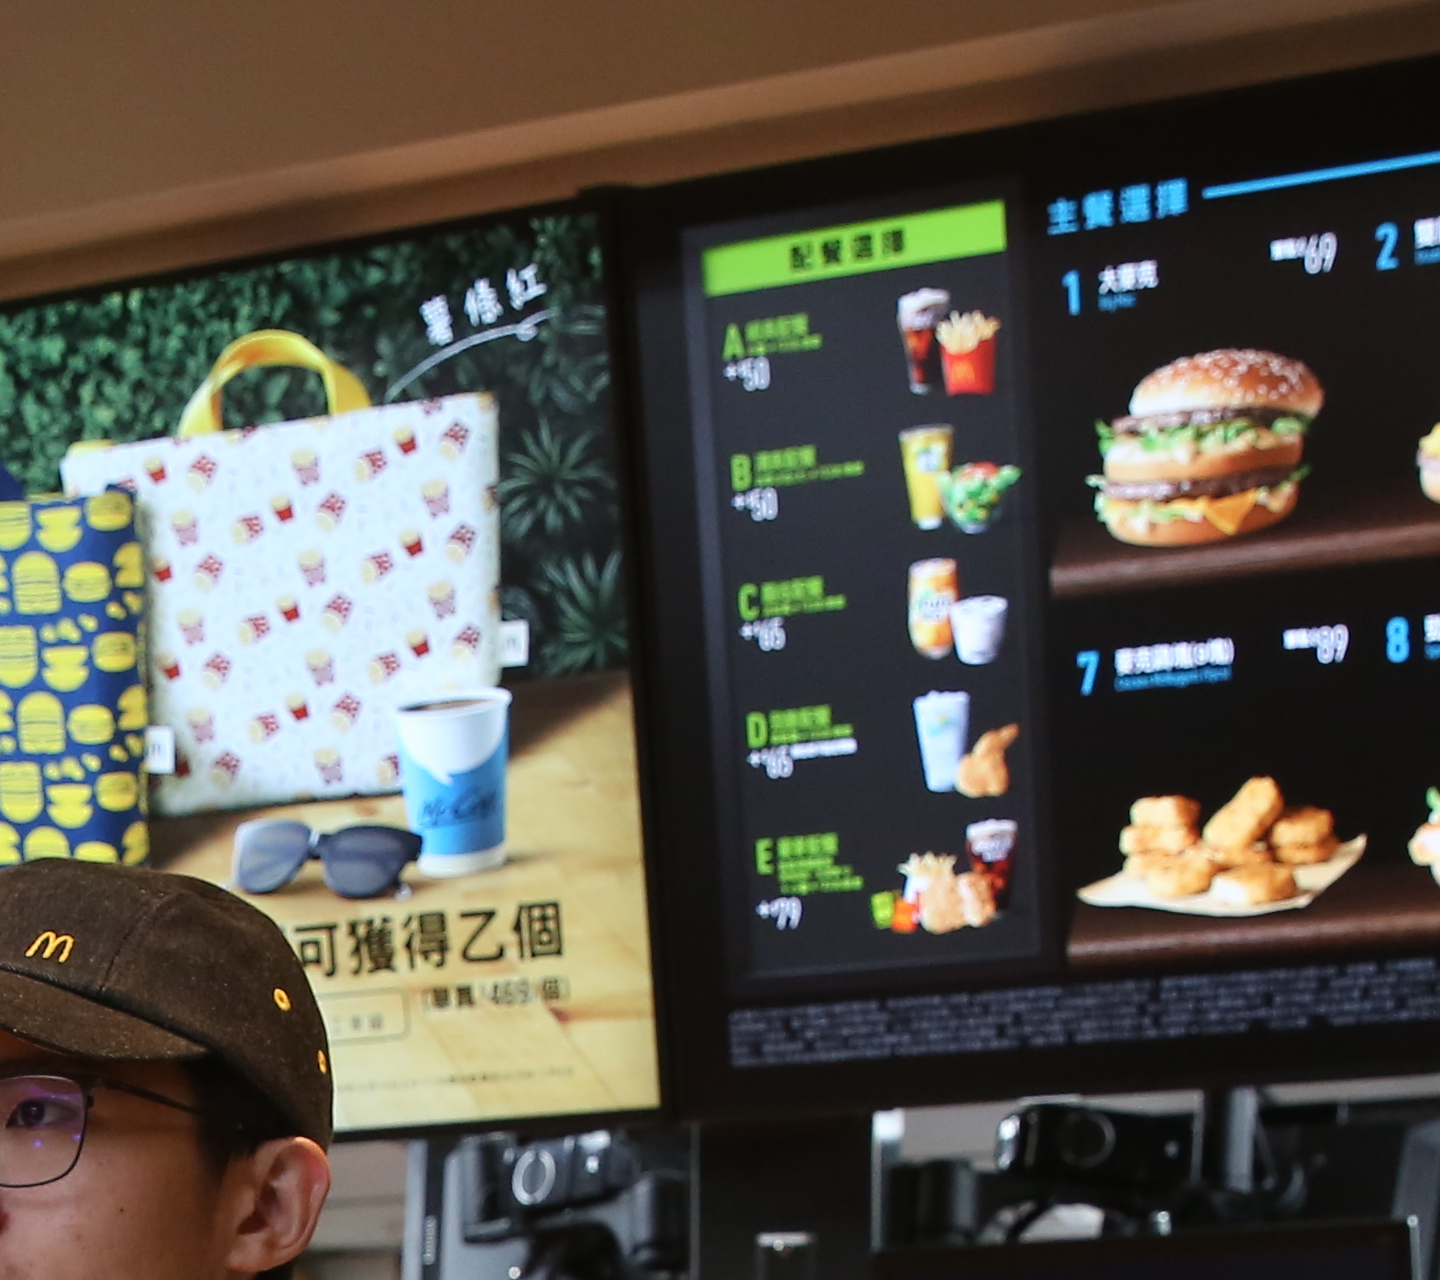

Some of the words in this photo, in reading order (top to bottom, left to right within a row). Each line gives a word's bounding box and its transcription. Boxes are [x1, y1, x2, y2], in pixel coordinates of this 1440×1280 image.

[1375, 221, 1400, 272] 2
[1062, 269, 1081, 315] 1
[723, 323, 746, 361] A
[738, 583, 760, 621] C
[1386, 616, 1410, 663] 8
[1076, 650, 1100, 695] 7
[746, 711, 768, 749] D
[755, 837, 775, 875] E
[280, 899, 565, 978] 可獲得乙個
